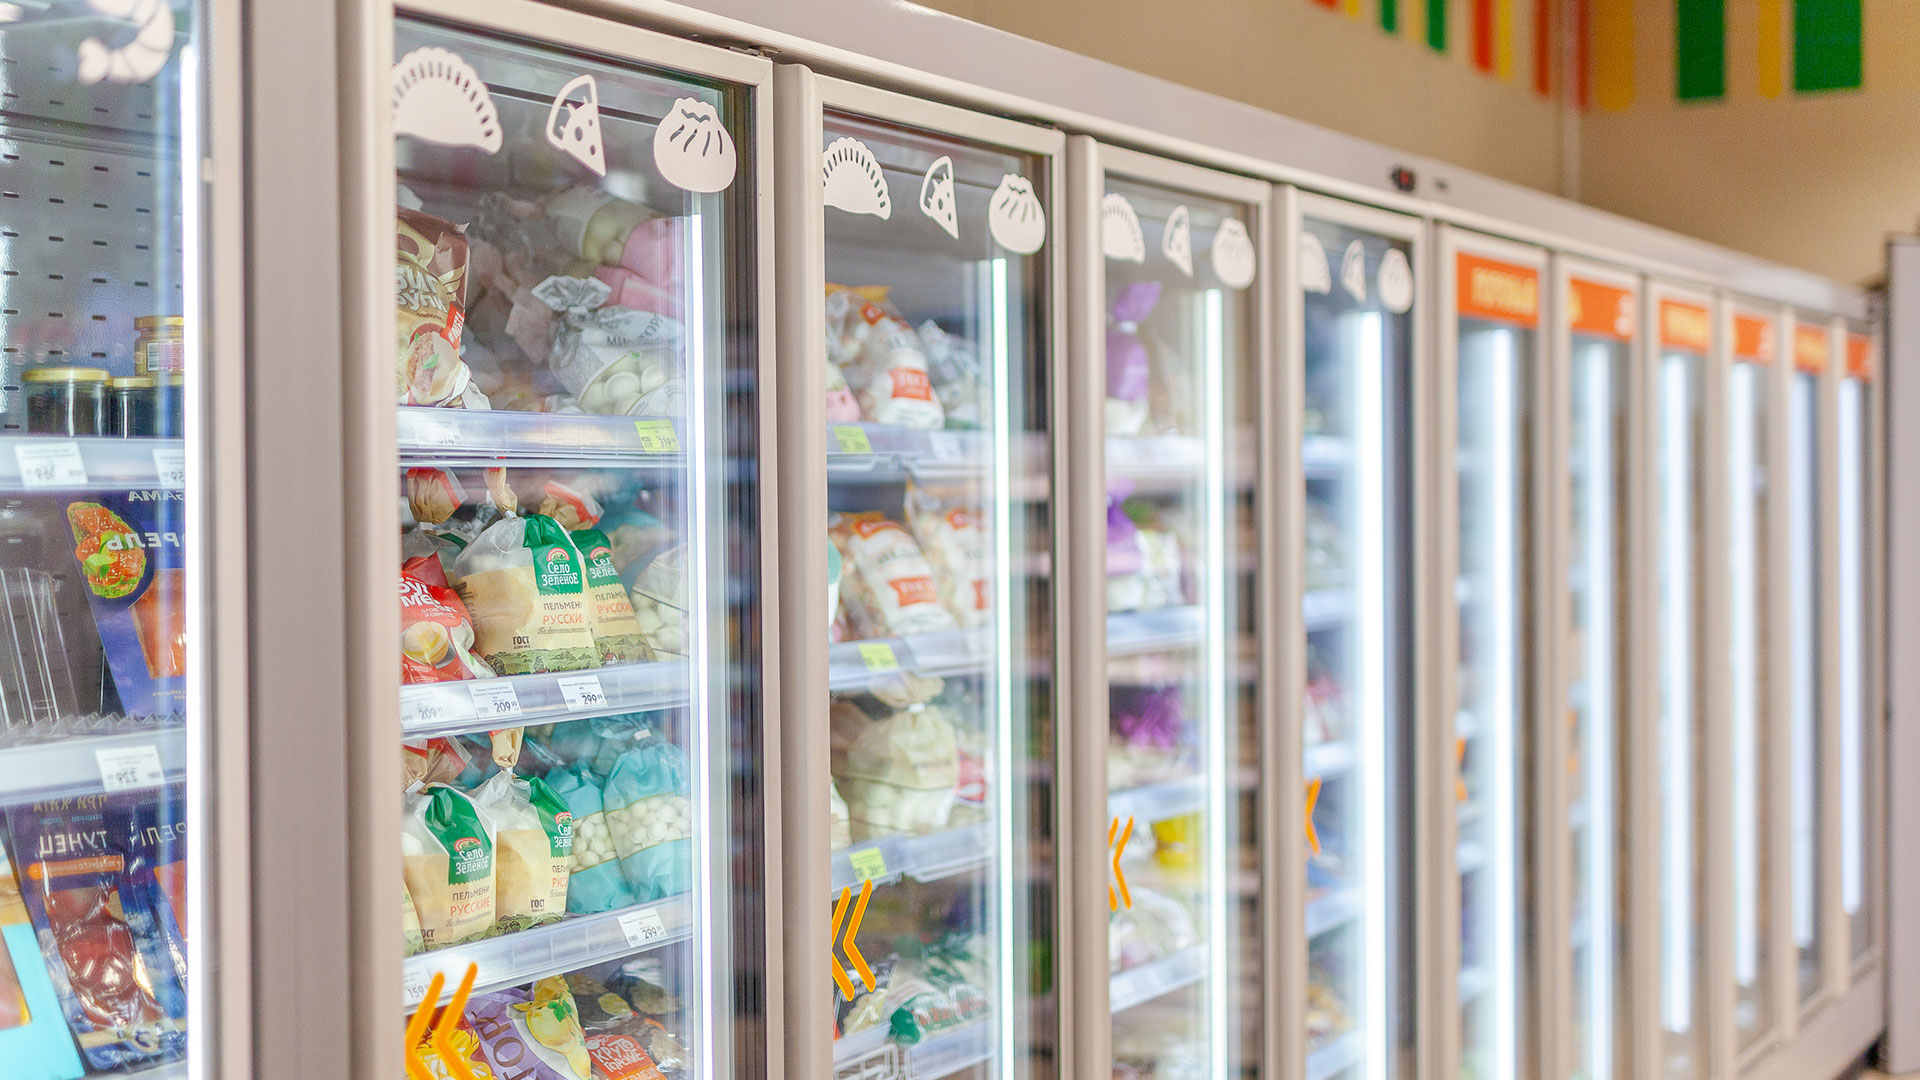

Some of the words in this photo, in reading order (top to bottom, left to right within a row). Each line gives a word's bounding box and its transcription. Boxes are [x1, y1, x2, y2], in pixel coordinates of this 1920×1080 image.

[547, 561, 571, 575] Село
[593, 556, 611, 568] Сел
[596, 601, 633, 616] РУССКИ
[542, 612, 584, 626] РУССКИ
[512, 635, 530, 646] ГОСТ
[581, 693, 598, 705] 299
[418, 706, 437, 721] 209
[493, 700, 512, 713] 209
[459, 847, 484, 861] Село
[452, 885, 490, 901] ПЕЛЬМЕНИ
[449, 896, 491, 917] РУССКИЕ
[641, 926, 657, 940] 299
[407, 984, 425, 1000] 159
[591, 1037, 635, 1063] КРУТО
